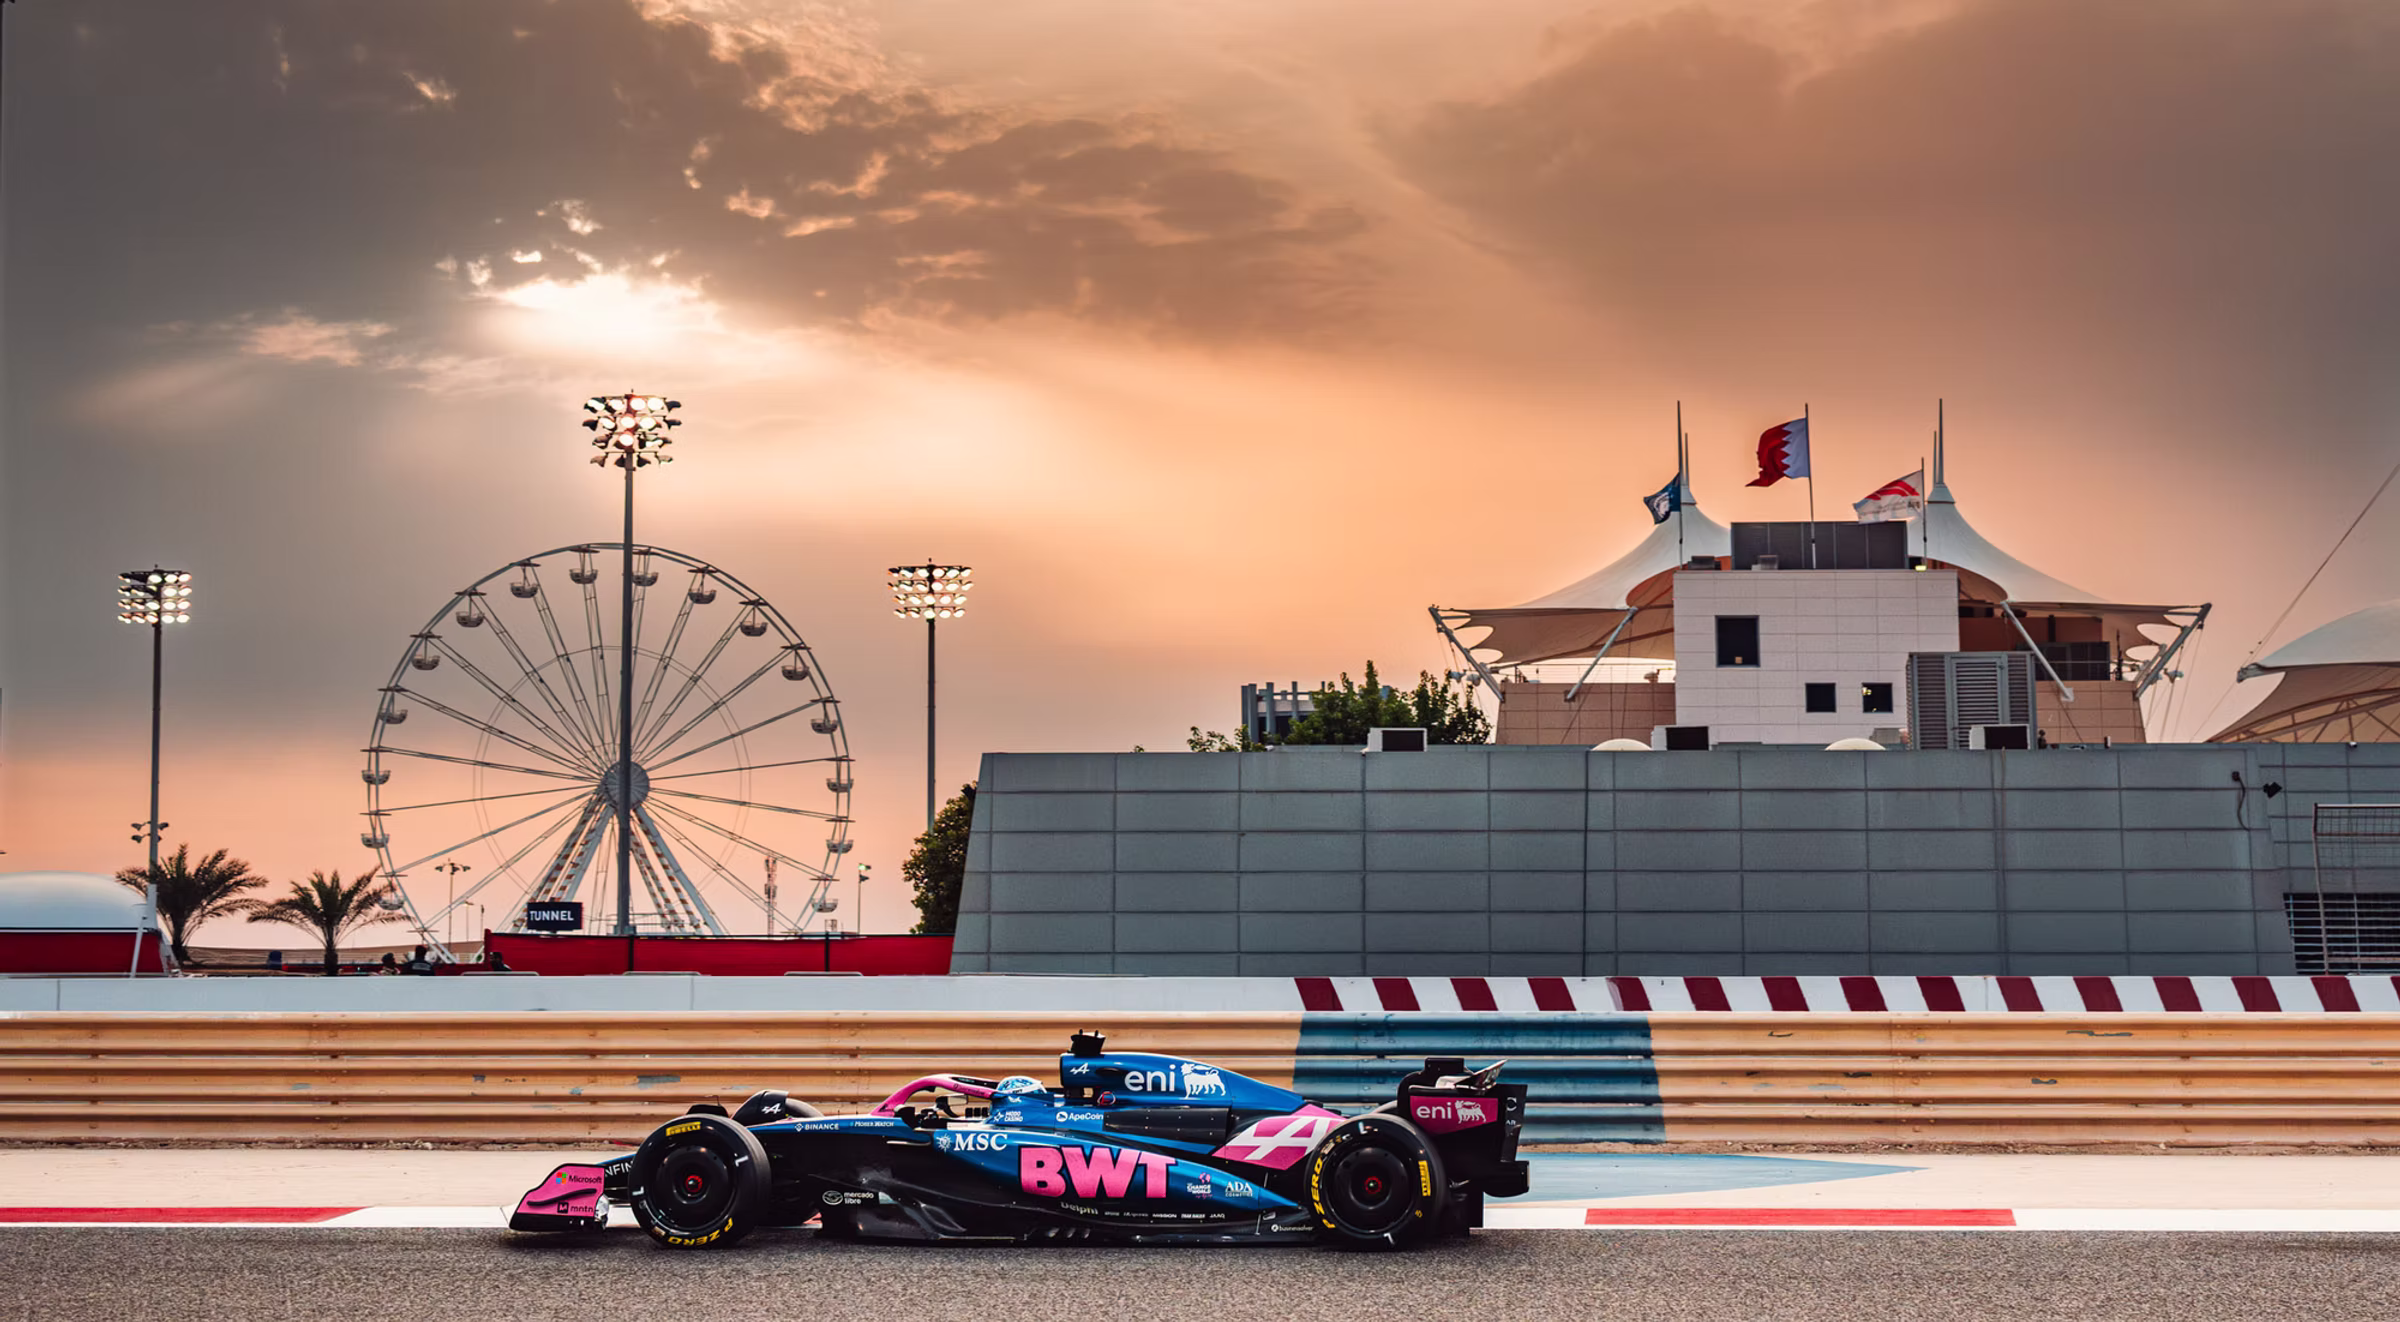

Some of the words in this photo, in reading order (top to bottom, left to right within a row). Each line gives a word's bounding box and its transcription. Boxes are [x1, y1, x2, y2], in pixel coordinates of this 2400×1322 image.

[530, 910, 574, 921] TUNNEL
[1124, 1064, 1176, 1092] eni
[1416, 1102, 1452, 1119] eni
[1068, 1112, 1104, 1122] ApeCoin
[804, 1123, 839, 1131] BINANCE
[953, 1132, 1008, 1151] MSC
[1020, 1147, 1177, 1199] BWT
[568, 1175, 603, 1185] Microsoft
[1225, 1181, 1253, 1192] ADA
[570, 1204, 594, 1213] mntn
[668, 1229, 721, 1247] ZERO
